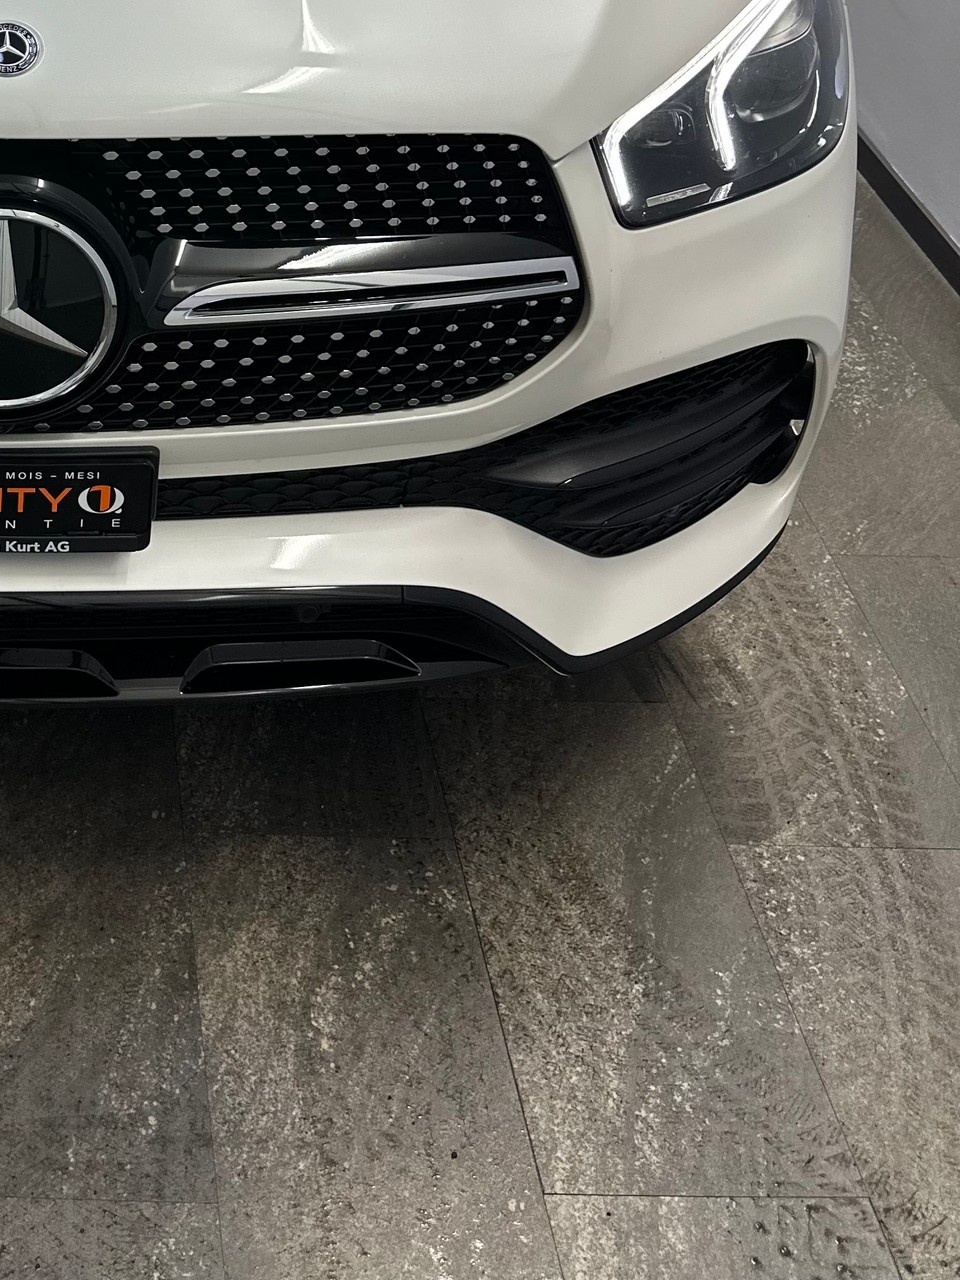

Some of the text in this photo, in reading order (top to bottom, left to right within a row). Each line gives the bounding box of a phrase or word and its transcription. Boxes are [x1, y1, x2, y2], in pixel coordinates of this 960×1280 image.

[5, 471, 43, 480] MOIS
[64, 471, 101, 480] MESI
[5, 540, 41, 552] Kurt
[44, 540, 70, 552] AG
